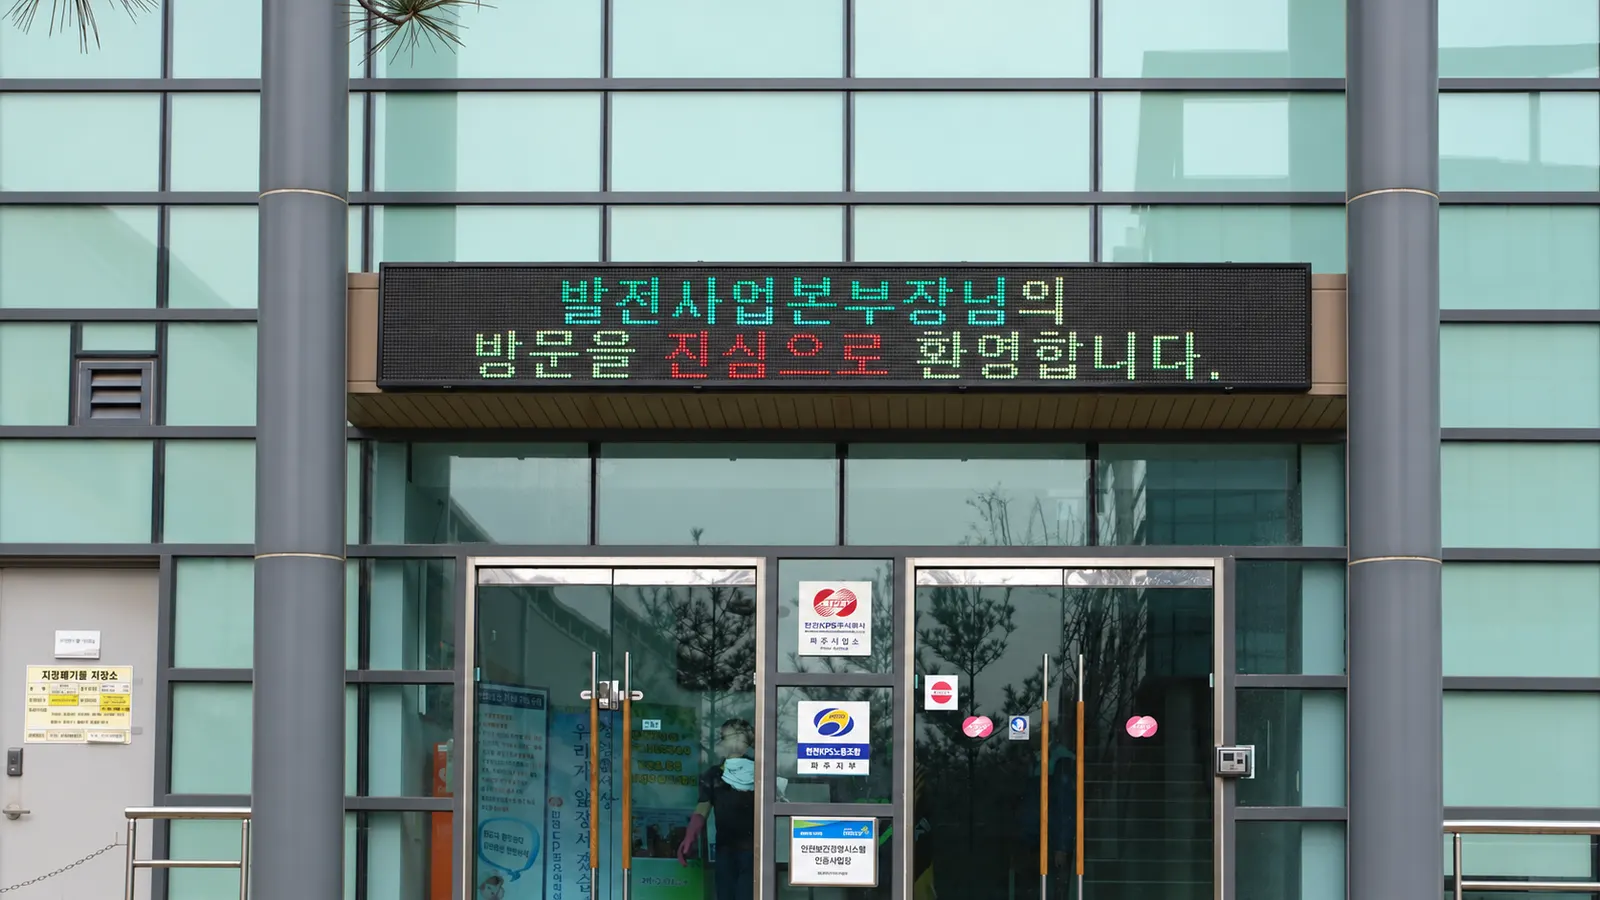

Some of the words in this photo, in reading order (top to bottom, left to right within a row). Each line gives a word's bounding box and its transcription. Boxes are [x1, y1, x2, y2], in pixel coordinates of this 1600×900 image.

[561, 276, 1064, 326] 발전사업본부장님의
[475, 329, 636, 379] 방문을
[664, 330, 889, 380] 진심으로
[915, 330, 1220, 380] 환영합니다.
